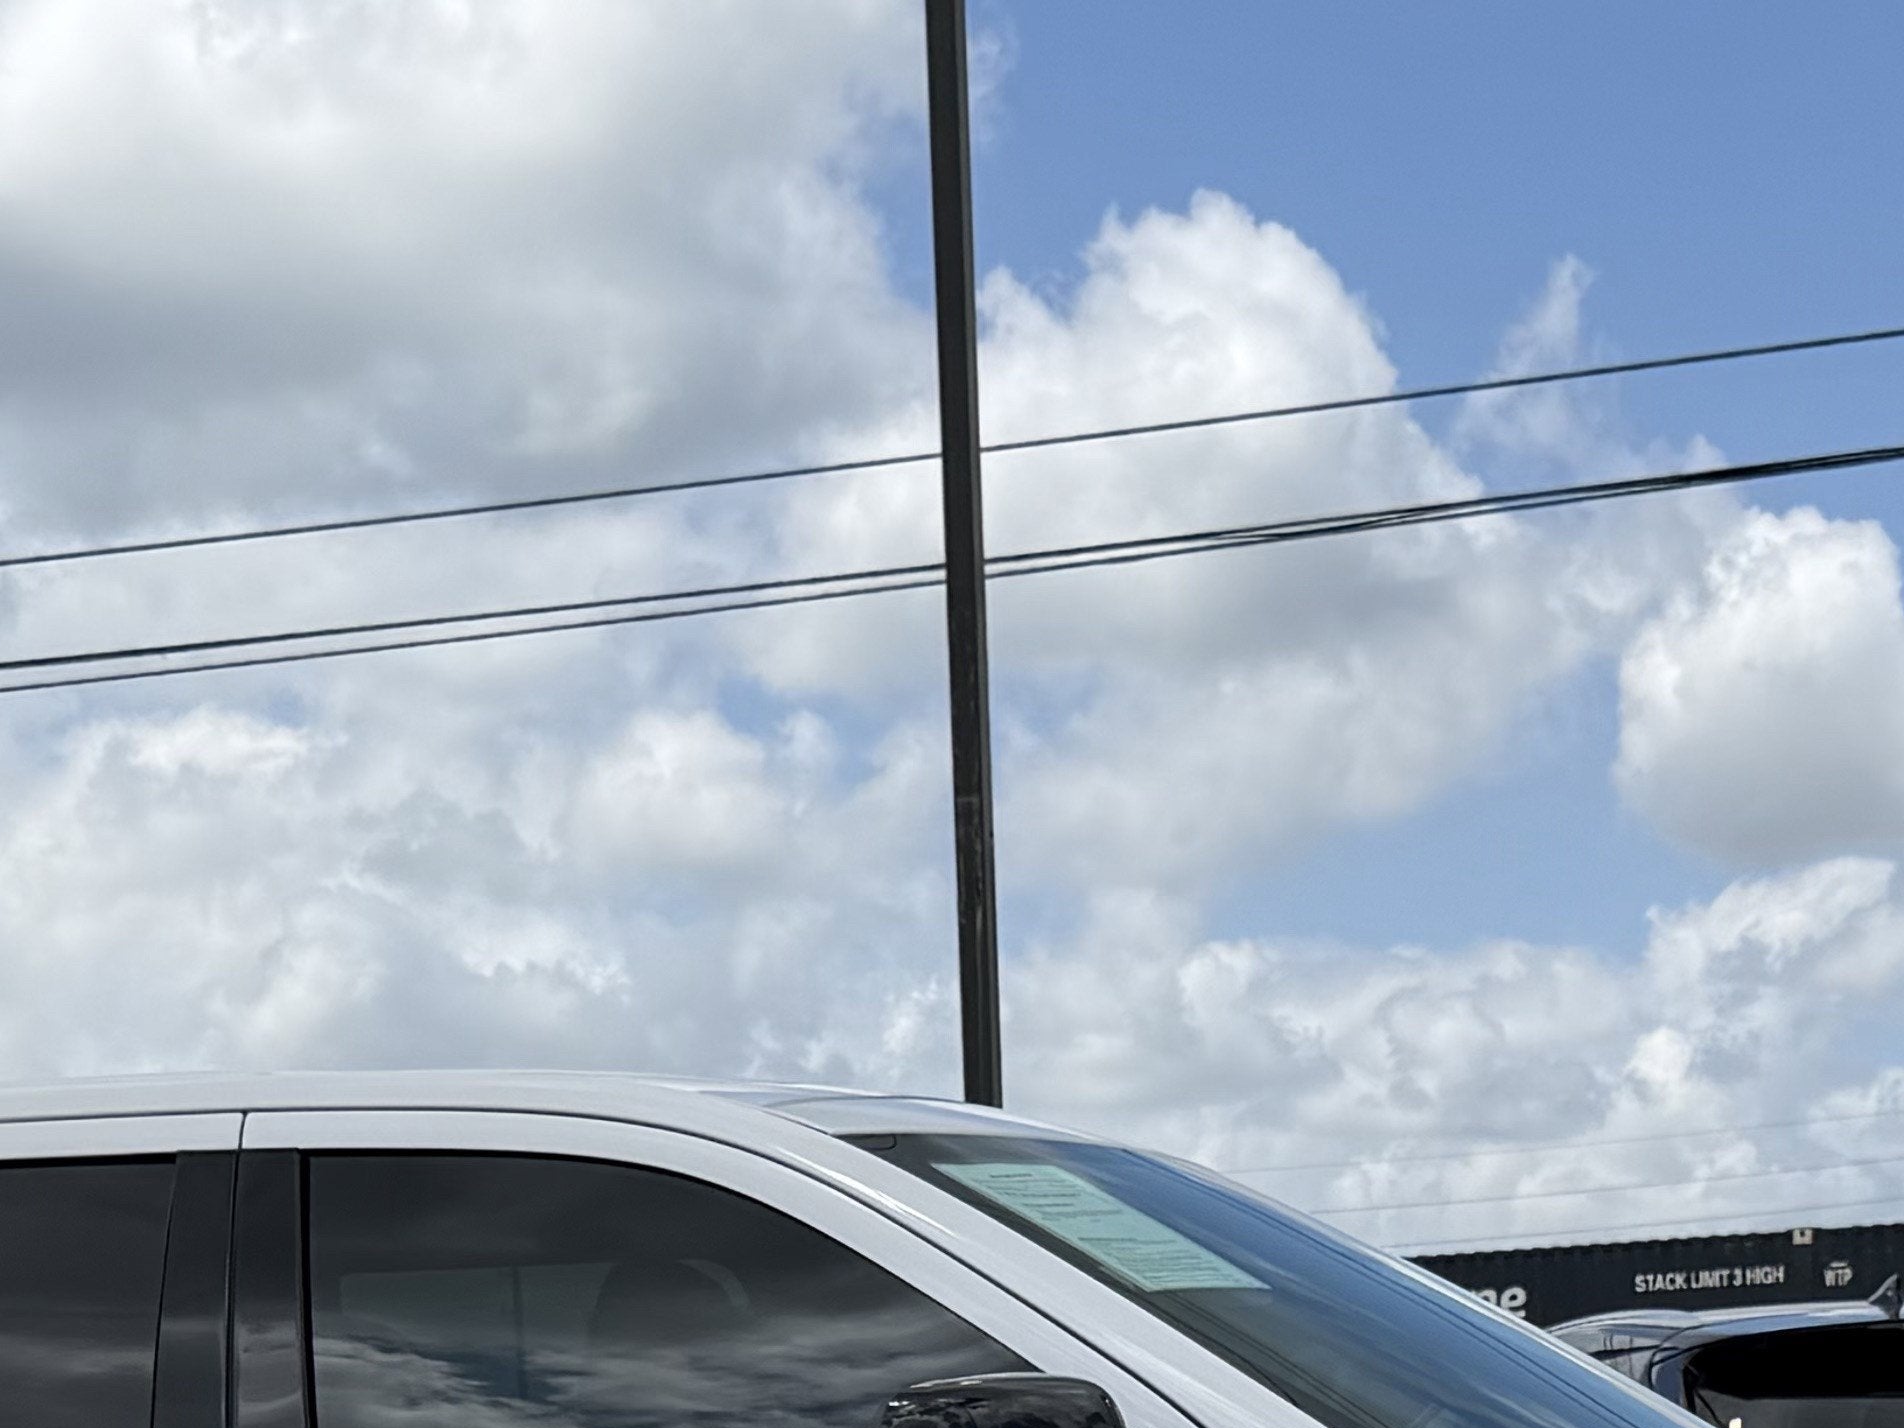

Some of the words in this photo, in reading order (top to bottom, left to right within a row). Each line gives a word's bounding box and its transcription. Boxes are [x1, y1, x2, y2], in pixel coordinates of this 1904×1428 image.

[1634, 1272, 1688, 1293] STACK
[1690, 1268, 1731, 1289] LIMIT
[1745, 1263, 1786, 1285] HIGH
